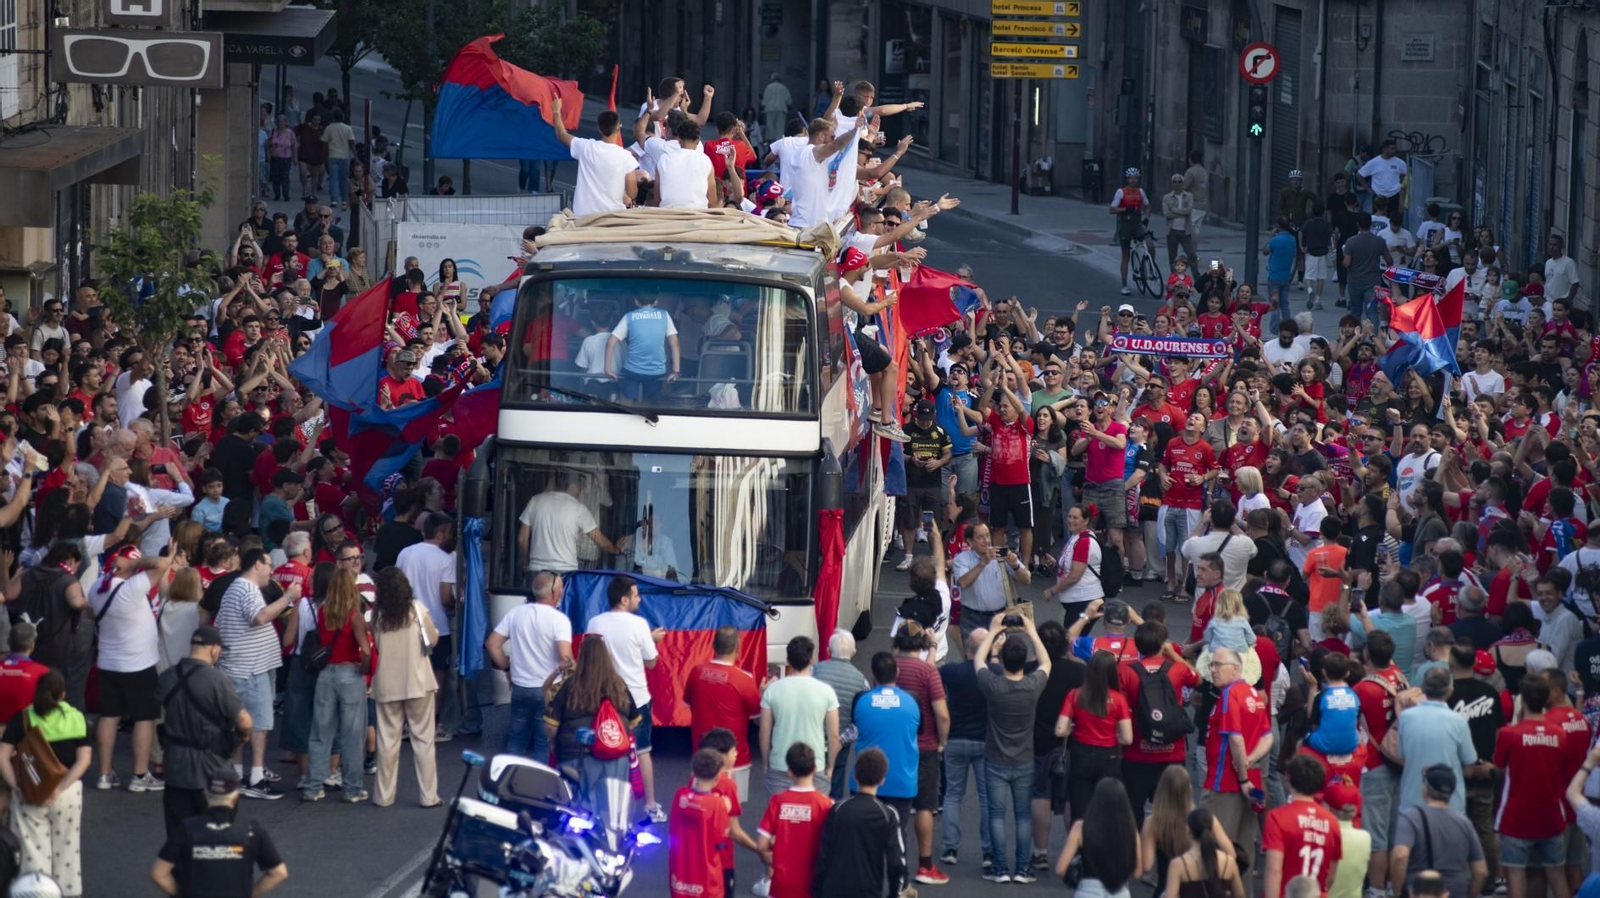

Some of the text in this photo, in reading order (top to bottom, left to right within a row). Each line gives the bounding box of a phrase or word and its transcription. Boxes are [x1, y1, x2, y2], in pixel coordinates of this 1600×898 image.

[246, 45, 284, 55] VARELA
[993, 46, 1058, 55] Barceló Ourense
